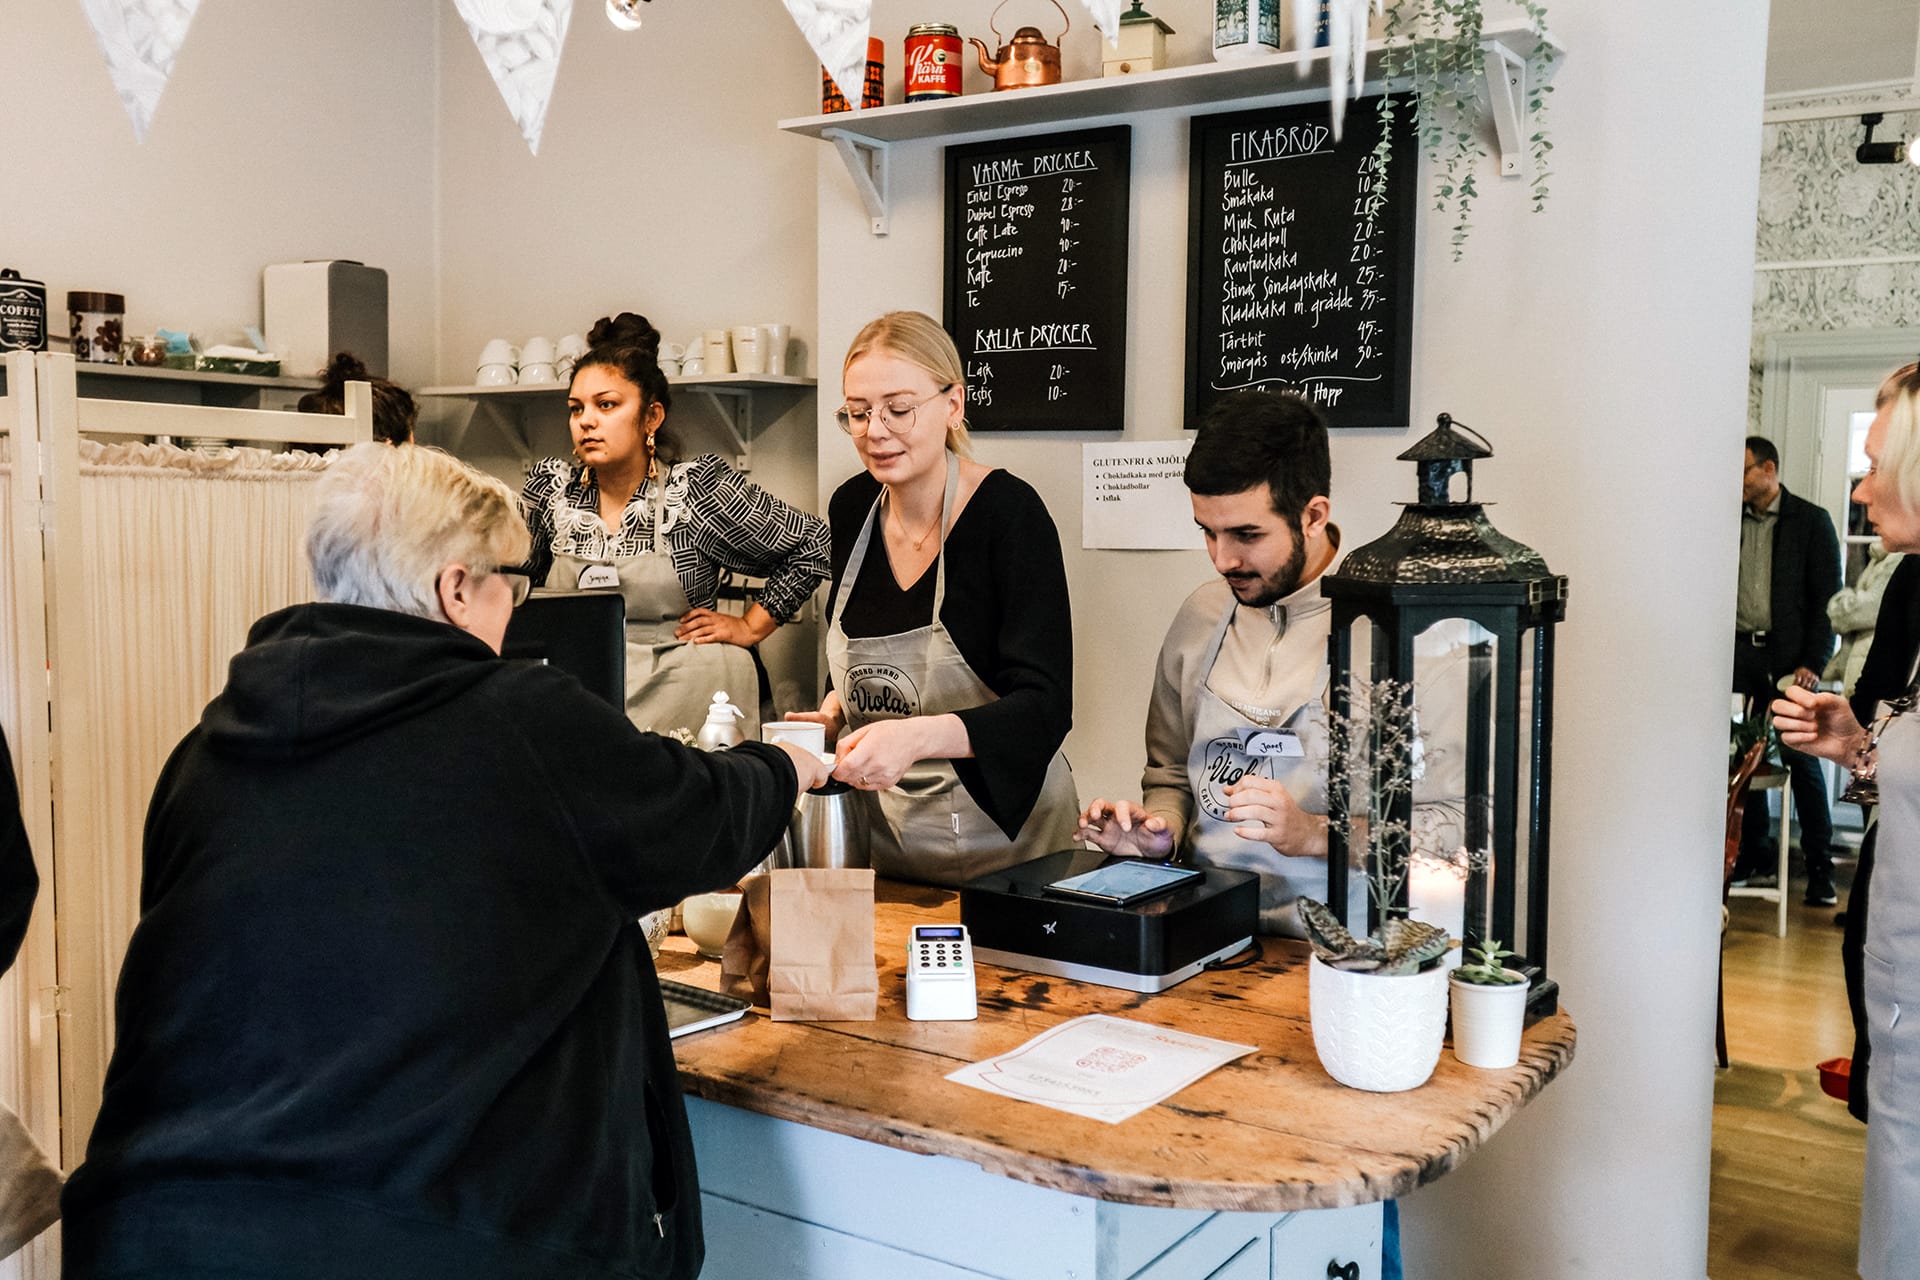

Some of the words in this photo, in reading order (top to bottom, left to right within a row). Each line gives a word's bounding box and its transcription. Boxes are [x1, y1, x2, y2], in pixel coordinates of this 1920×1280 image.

[917, 74, 946, 84] KAFFE
[1231, 122, 1329, 160] FIKABRÖD
[972, 158, 1023, 184] VARMA
[1033, 150, 1095, 174] DRYCKER
[1224, 168, 1259, 191] Bulle
[967, 185, 991, 204] Enkel
[997, 184, 1029, 202] Espresso
[1222, 184, 1274, 211] Småkaka
[967, 205, 996, 223] Dubbel
[1001, 203, 1035, 221] Espresso
[1224, 211, 1257, 241] Mjuk
[1264, 206, 1295, 229] Ruta
[1353, 222, 1385, 242] 20:-
[966, 244, 1023, 268] Cappuccino
[1350, 244, 1384, 262] 20:-
[1222, 280, 1256, 302] Stinas
[1263, 268, 1338, 301] Söndagskaka
[1356, 265, 1385, 285] 25:-
[966, 290, 980, 307] Te
[1221, 300, 1286, 327] Kladdkaka
[1311, 285, 1353, 328] grädde
[1360, 288, 1387, 311] 35:-
[0, 304, 41, 317] COFFEE
[975, 327, 1025, 351] KALLA
[1030, 323, 1093, 347] DRYCKER
[1219, 330, 1266, 352] Tårtbit
[1357, 320, 1384, 344] 45:-
[967, 361, 994, 385] Läsk
[1049, 364, 1071, 380] 20:-
[1220, 351, 1268, 381] Smörgås
[1355, 345, 1383, 368] 30:-
[967, 385, 992, 406] Festis
[1048, 385, 1068, 401] 10:-
[1313, 381, 1343, 407] Hopp
[1093, 457, 1144, 467] GLUTENFRI
[1146, 457, 1154, 465] &
[1102, 471, 1147, 480] Chokladkaka
[1102, 483, 1150, 491] Chokladbollar
[849, 668, 873, 680] SECOND
[877, 668, 899, 680] HAND
[850, 686, 912, 715] Violas
